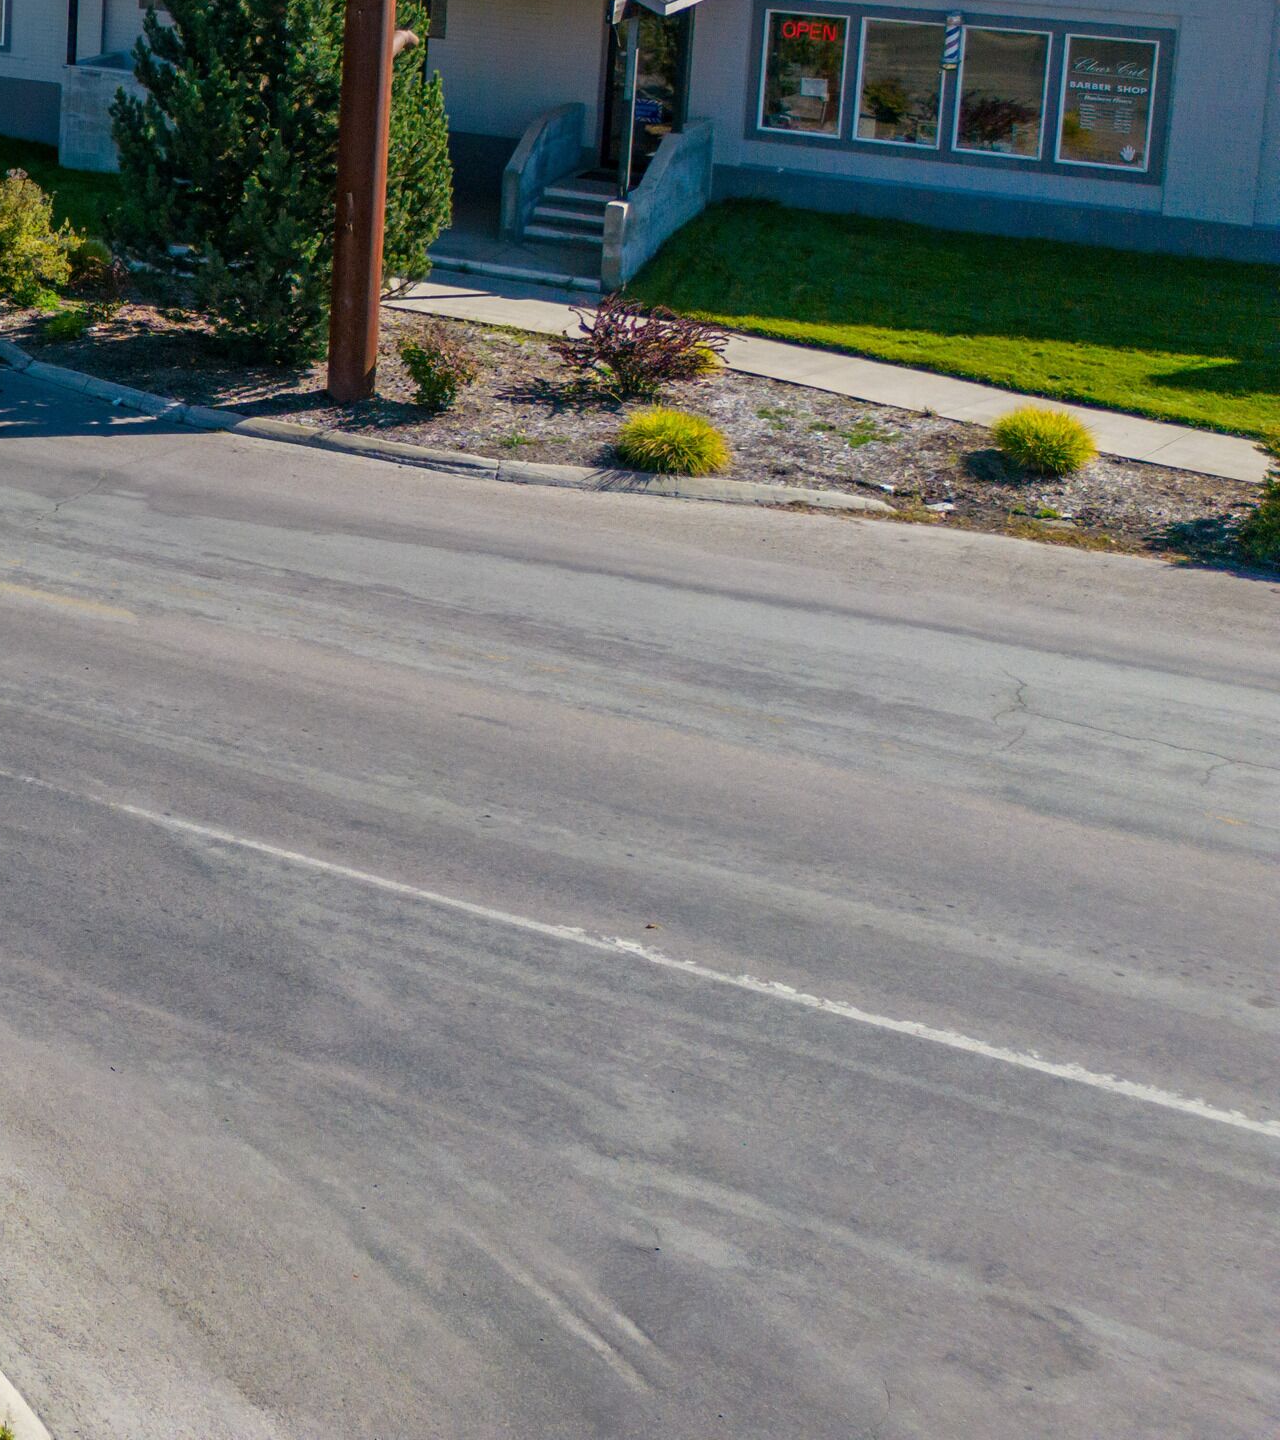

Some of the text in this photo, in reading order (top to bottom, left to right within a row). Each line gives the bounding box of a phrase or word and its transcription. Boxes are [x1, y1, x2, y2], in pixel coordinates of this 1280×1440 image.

[782, 21, 837, 42] OPEN
[1116, 60, 1148, 77] Cut
[1069, 80, 1148, 95] BARBER SHOP
